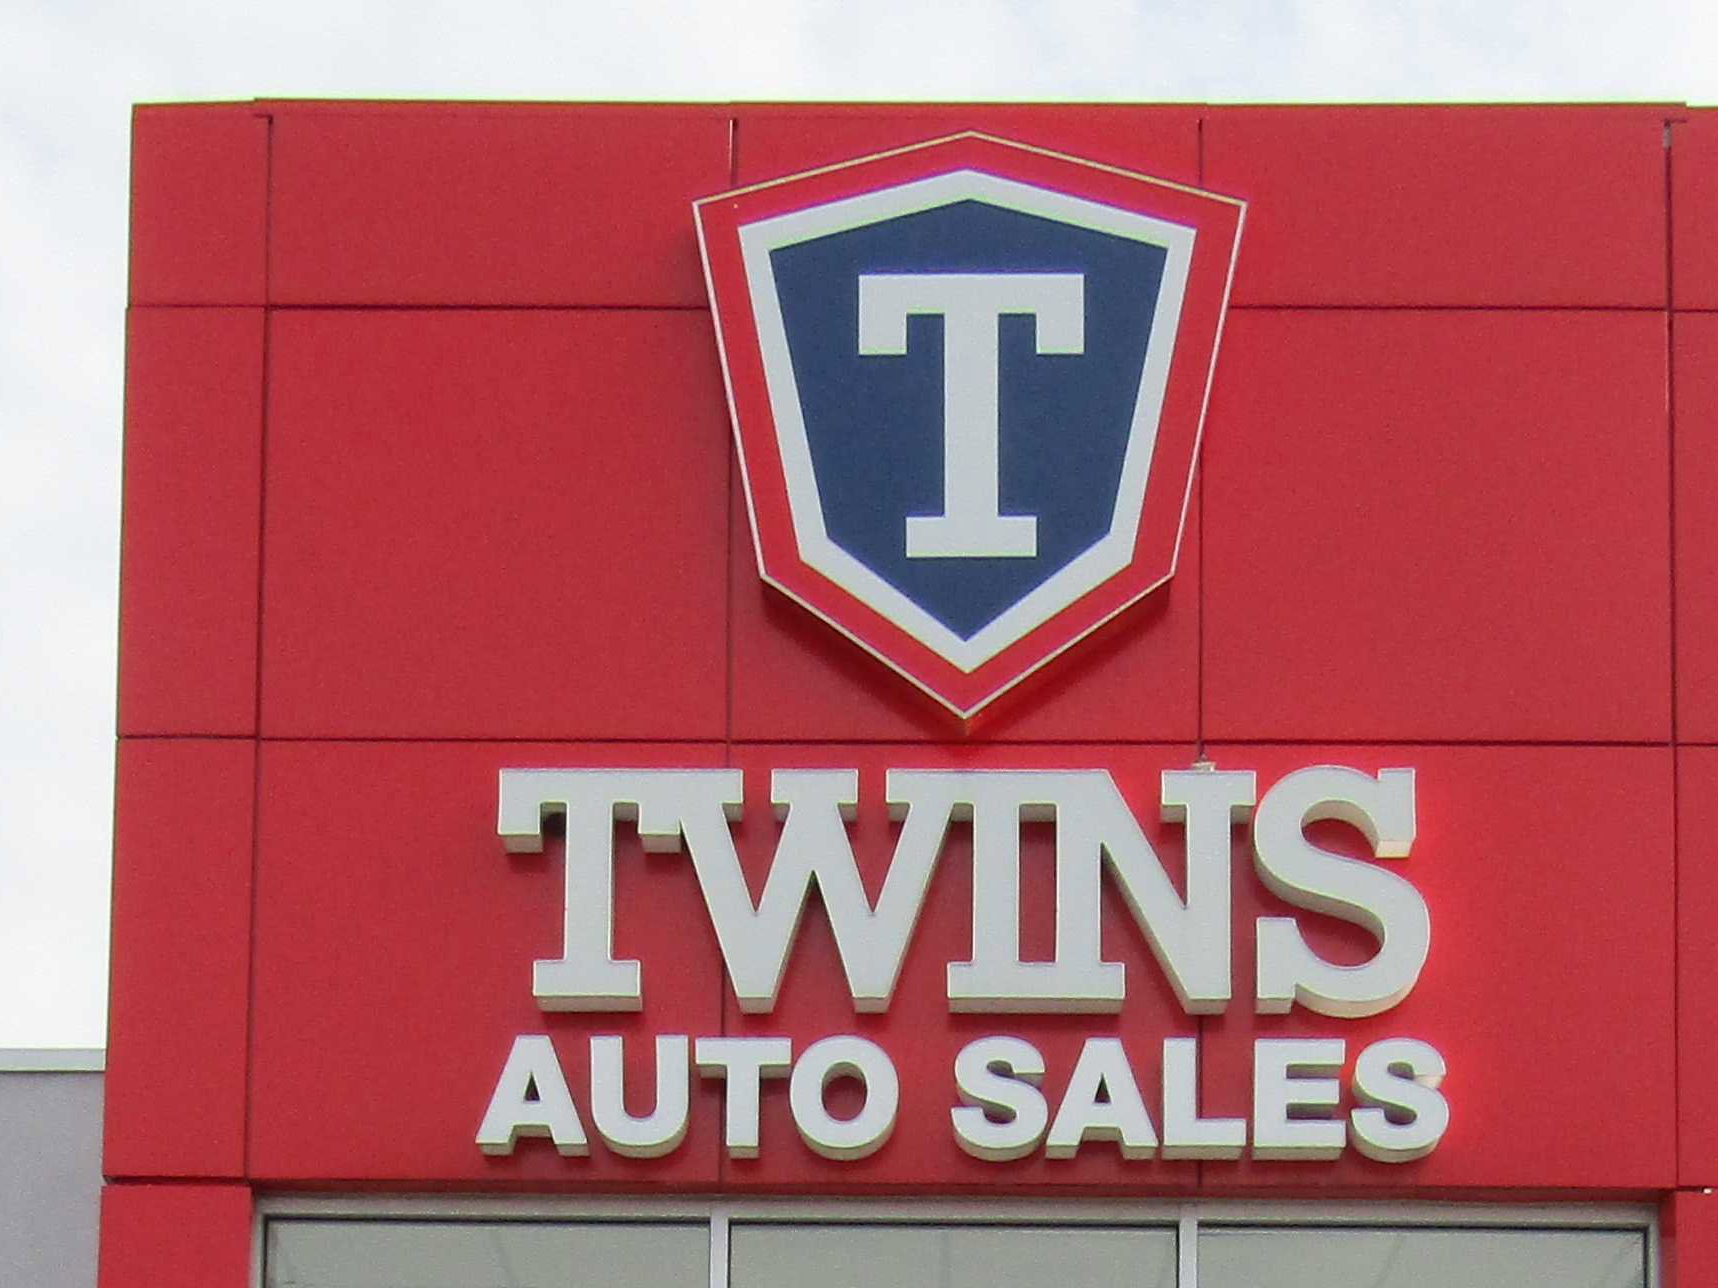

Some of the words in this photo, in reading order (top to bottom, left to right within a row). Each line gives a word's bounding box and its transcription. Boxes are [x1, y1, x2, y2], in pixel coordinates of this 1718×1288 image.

[859, 272, 1085, 558] T
[497, 765, 1431, 1018] TWINS
[476, 1034, 899, 1161] AUTO
[950, 1035, 1450, 1162] SALES
